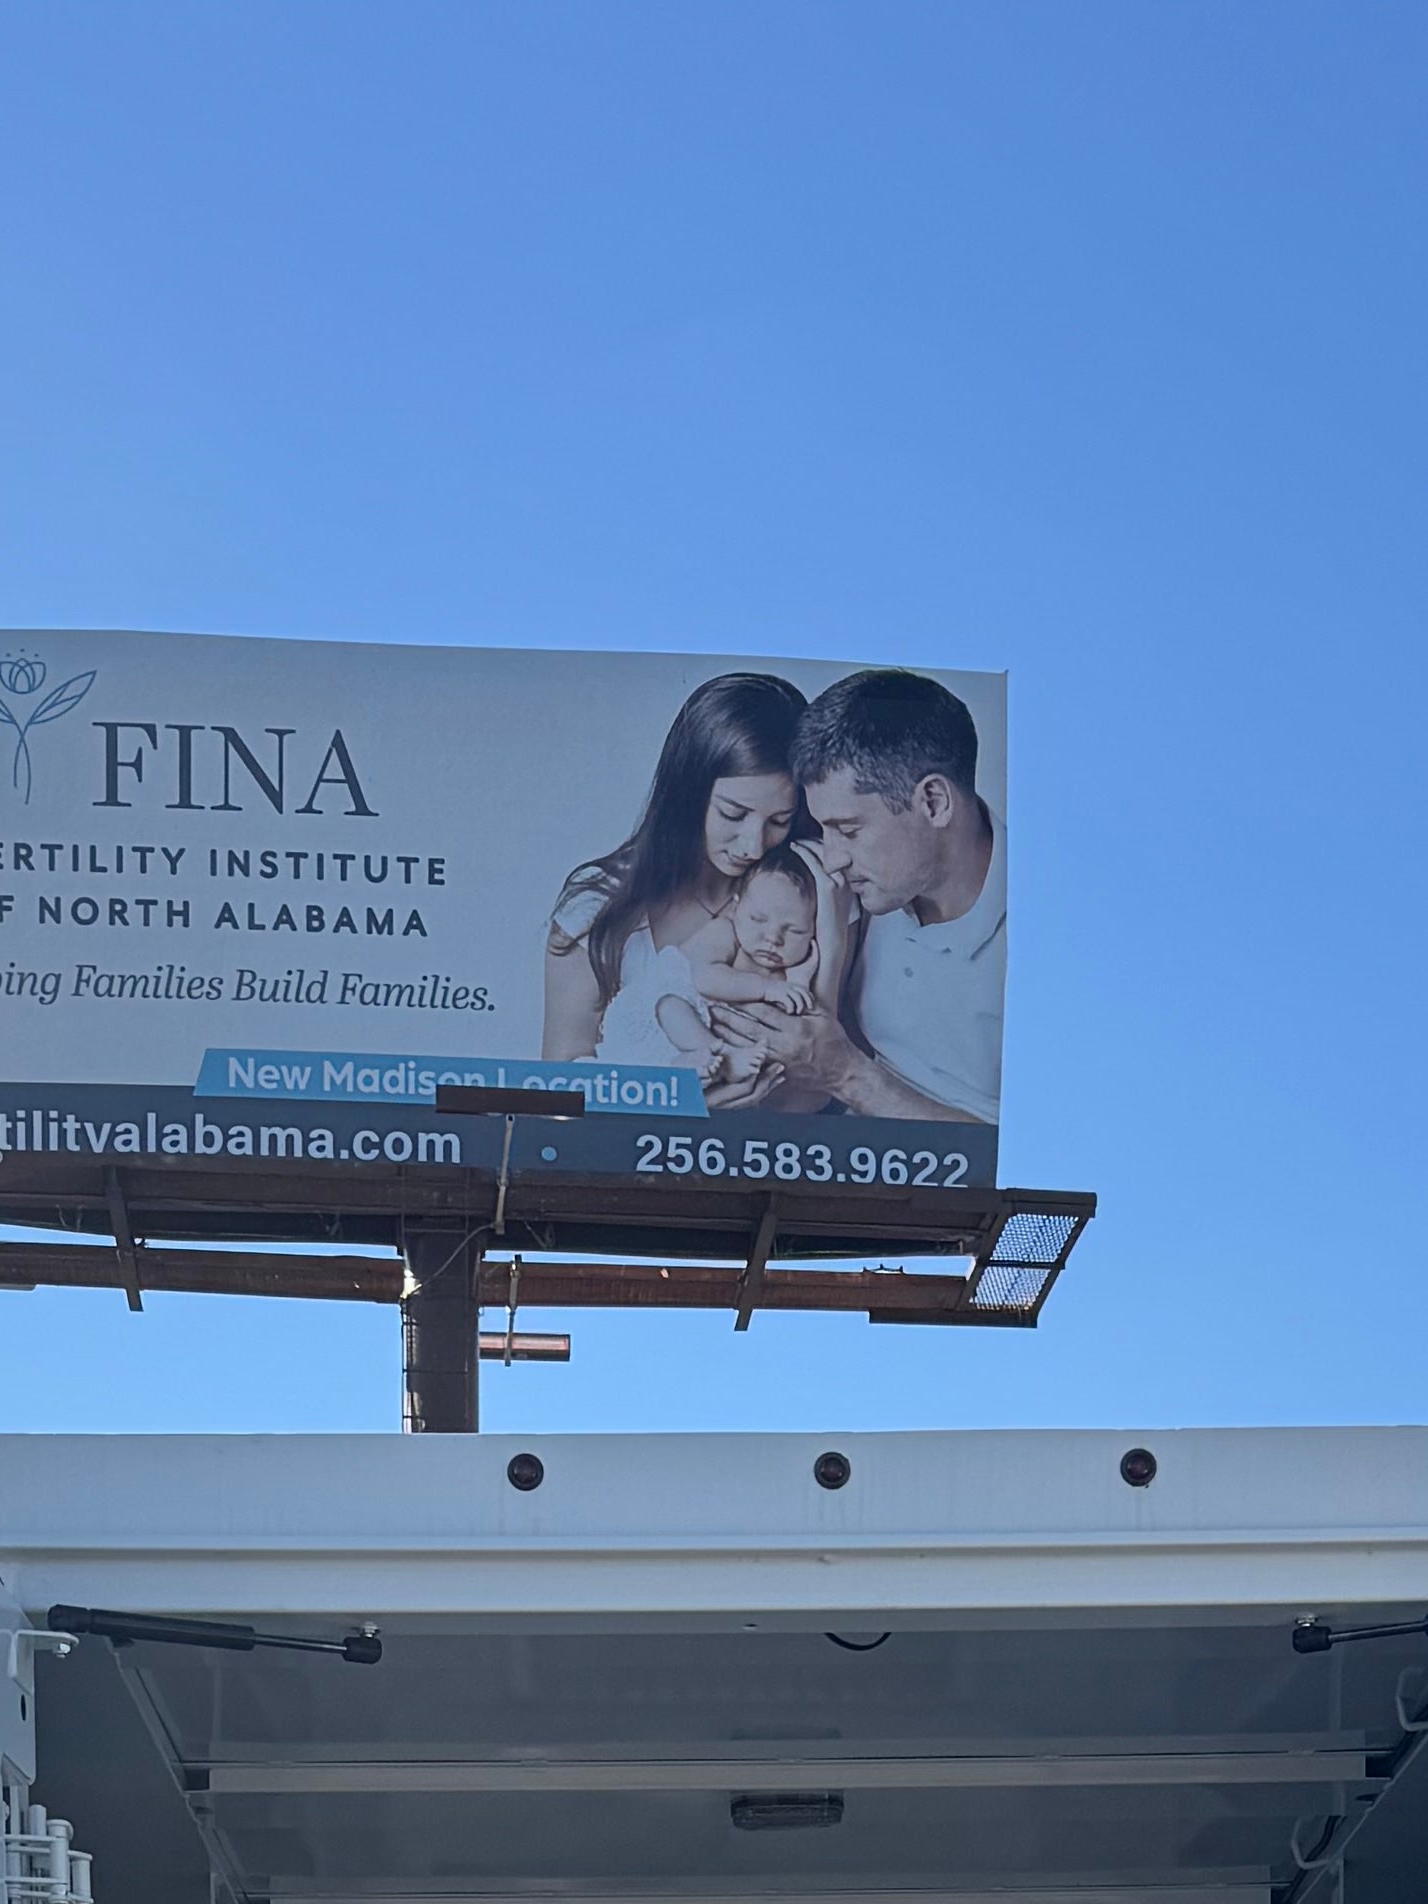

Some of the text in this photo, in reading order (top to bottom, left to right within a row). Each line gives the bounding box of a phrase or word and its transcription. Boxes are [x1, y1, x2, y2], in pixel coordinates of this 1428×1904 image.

[91, 721, 380, 817] FINA
[209, 848, 446, 886] INSTITUTE
[38, 895, 191, 928] NORTH
[214, 901, 429, 938] ALABAMA
[70, 963, 224, 1002] Families
[231, 968, 329, 1005] Build
[335, 971, 497, 1013] Families.
[227, 1056, 312, 1091] New
[635, 1133, 970, 1189] 256.583.9622
